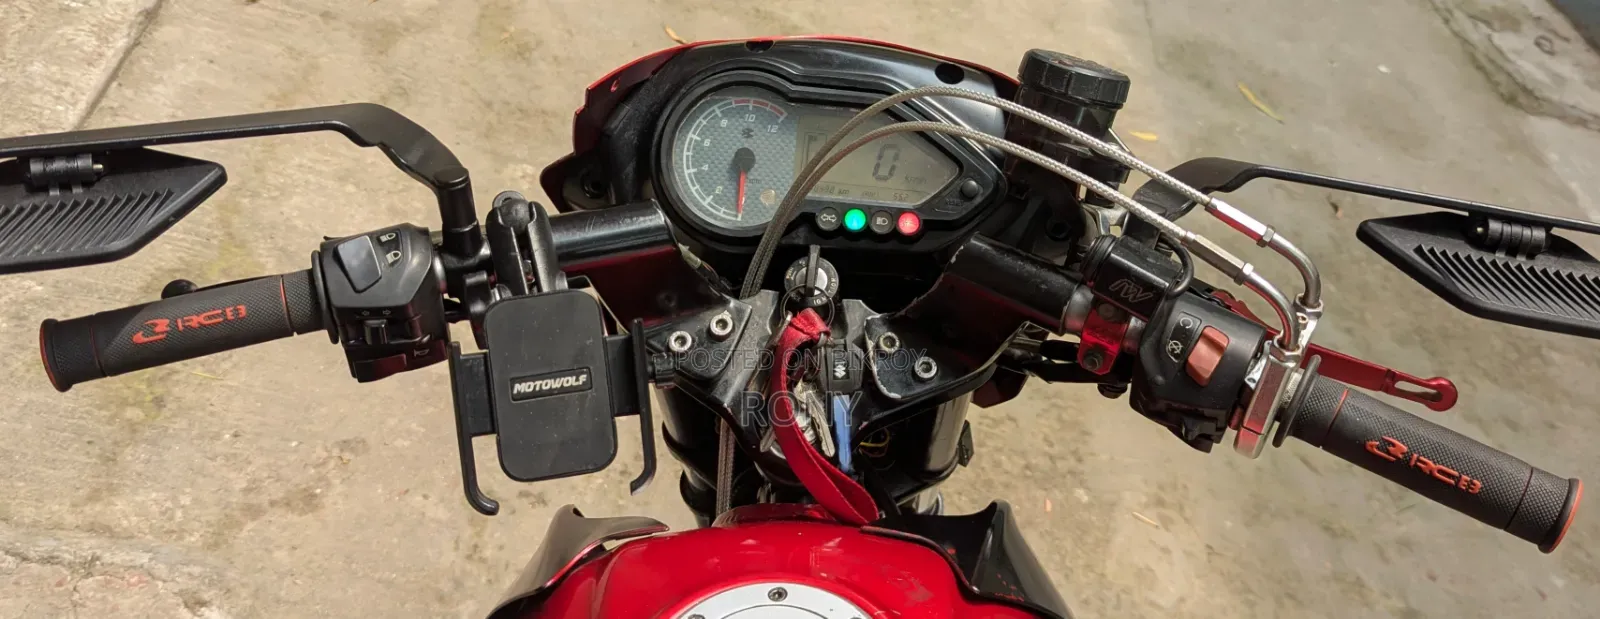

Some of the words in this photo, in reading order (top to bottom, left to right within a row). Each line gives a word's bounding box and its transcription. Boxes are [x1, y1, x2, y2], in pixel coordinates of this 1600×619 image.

[744, 114, 756, 122] 10
[720, 119, 728, 128] 8
[767, 124, 779, 133] 12
[703, 139, 711, 147] 6
[872, 143, 900, 181] 0
[715, 185, 723, 194] 2
[176, 304, 247, 332] RCB
[513, 374, 587, 394] MOTOWOLF
[1409, 453, 1481, 494] RCB
